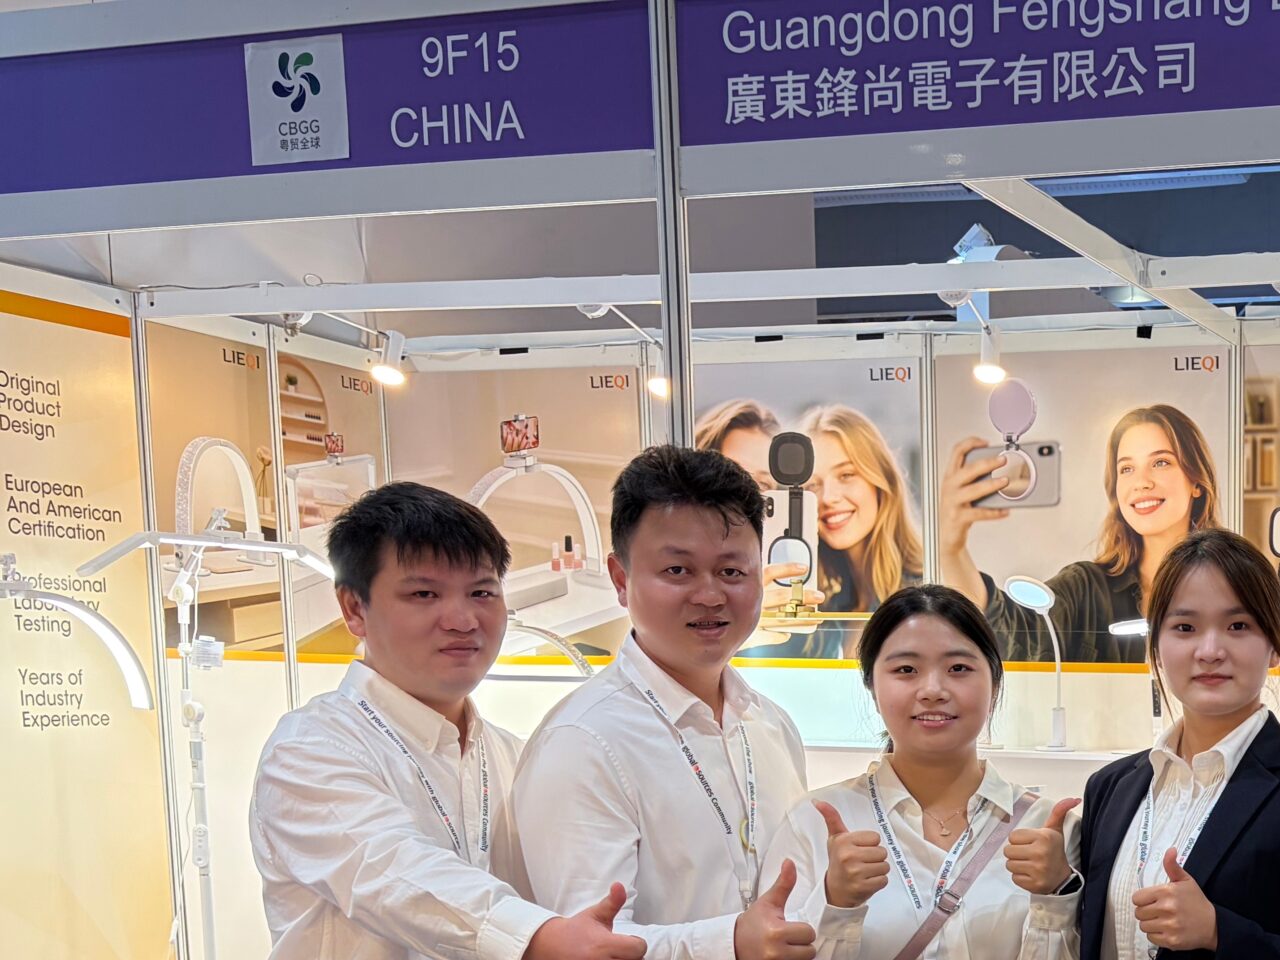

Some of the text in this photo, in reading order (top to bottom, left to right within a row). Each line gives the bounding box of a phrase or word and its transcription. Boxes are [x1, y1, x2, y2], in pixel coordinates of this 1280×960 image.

[722, 0, 974, 56] Guangdong
[421, 30, 520, 78] 9F15
[724, 42, 1196, 125] 廣東鋒尚電子有限公司
[278, 119, 320, 136] CBGG
[390, 100, 525, 148] CHINA
[279, 137, 321, 151] 粤贸全球
[222, 348, 260, 370] LIEQI
[1174, 355, 1220, 373] LIEQI
[0, 370, 61, 397] Original
[340, 374, 374, 395] LIEQI
[589, 374, 630, 390] LIEQI
[869, 366, 912, 383] LIEQI
[0, 414, 55, 441] Design
[5, 474, 84, 498] European
[7, 496, 122, 523] And American
[8, 518, 106, 541] Certification
[14, 596, 100, 612] Labory
[14, 614, 71, 637] Testing
[18, 669, 83, 685] Years of
[20, 691, 83, 709] Industry
[22, 711, 110, 731] Experience
[358, 700, 374, 716] Start
[371, 714, 387, 729] your
[384, 729, 409, 755] sourcing
[432, 795, 448, 817] global
[682, 745, 698, 767] global
[696, 770, 714, 797] sources
[711, 797, 733, 834] Community
[480, 818, 489, 852] Community
[880, 822, 895, 846] journey
[891, 845, 902, 860] with
[908, 884, 922, 909] sources
